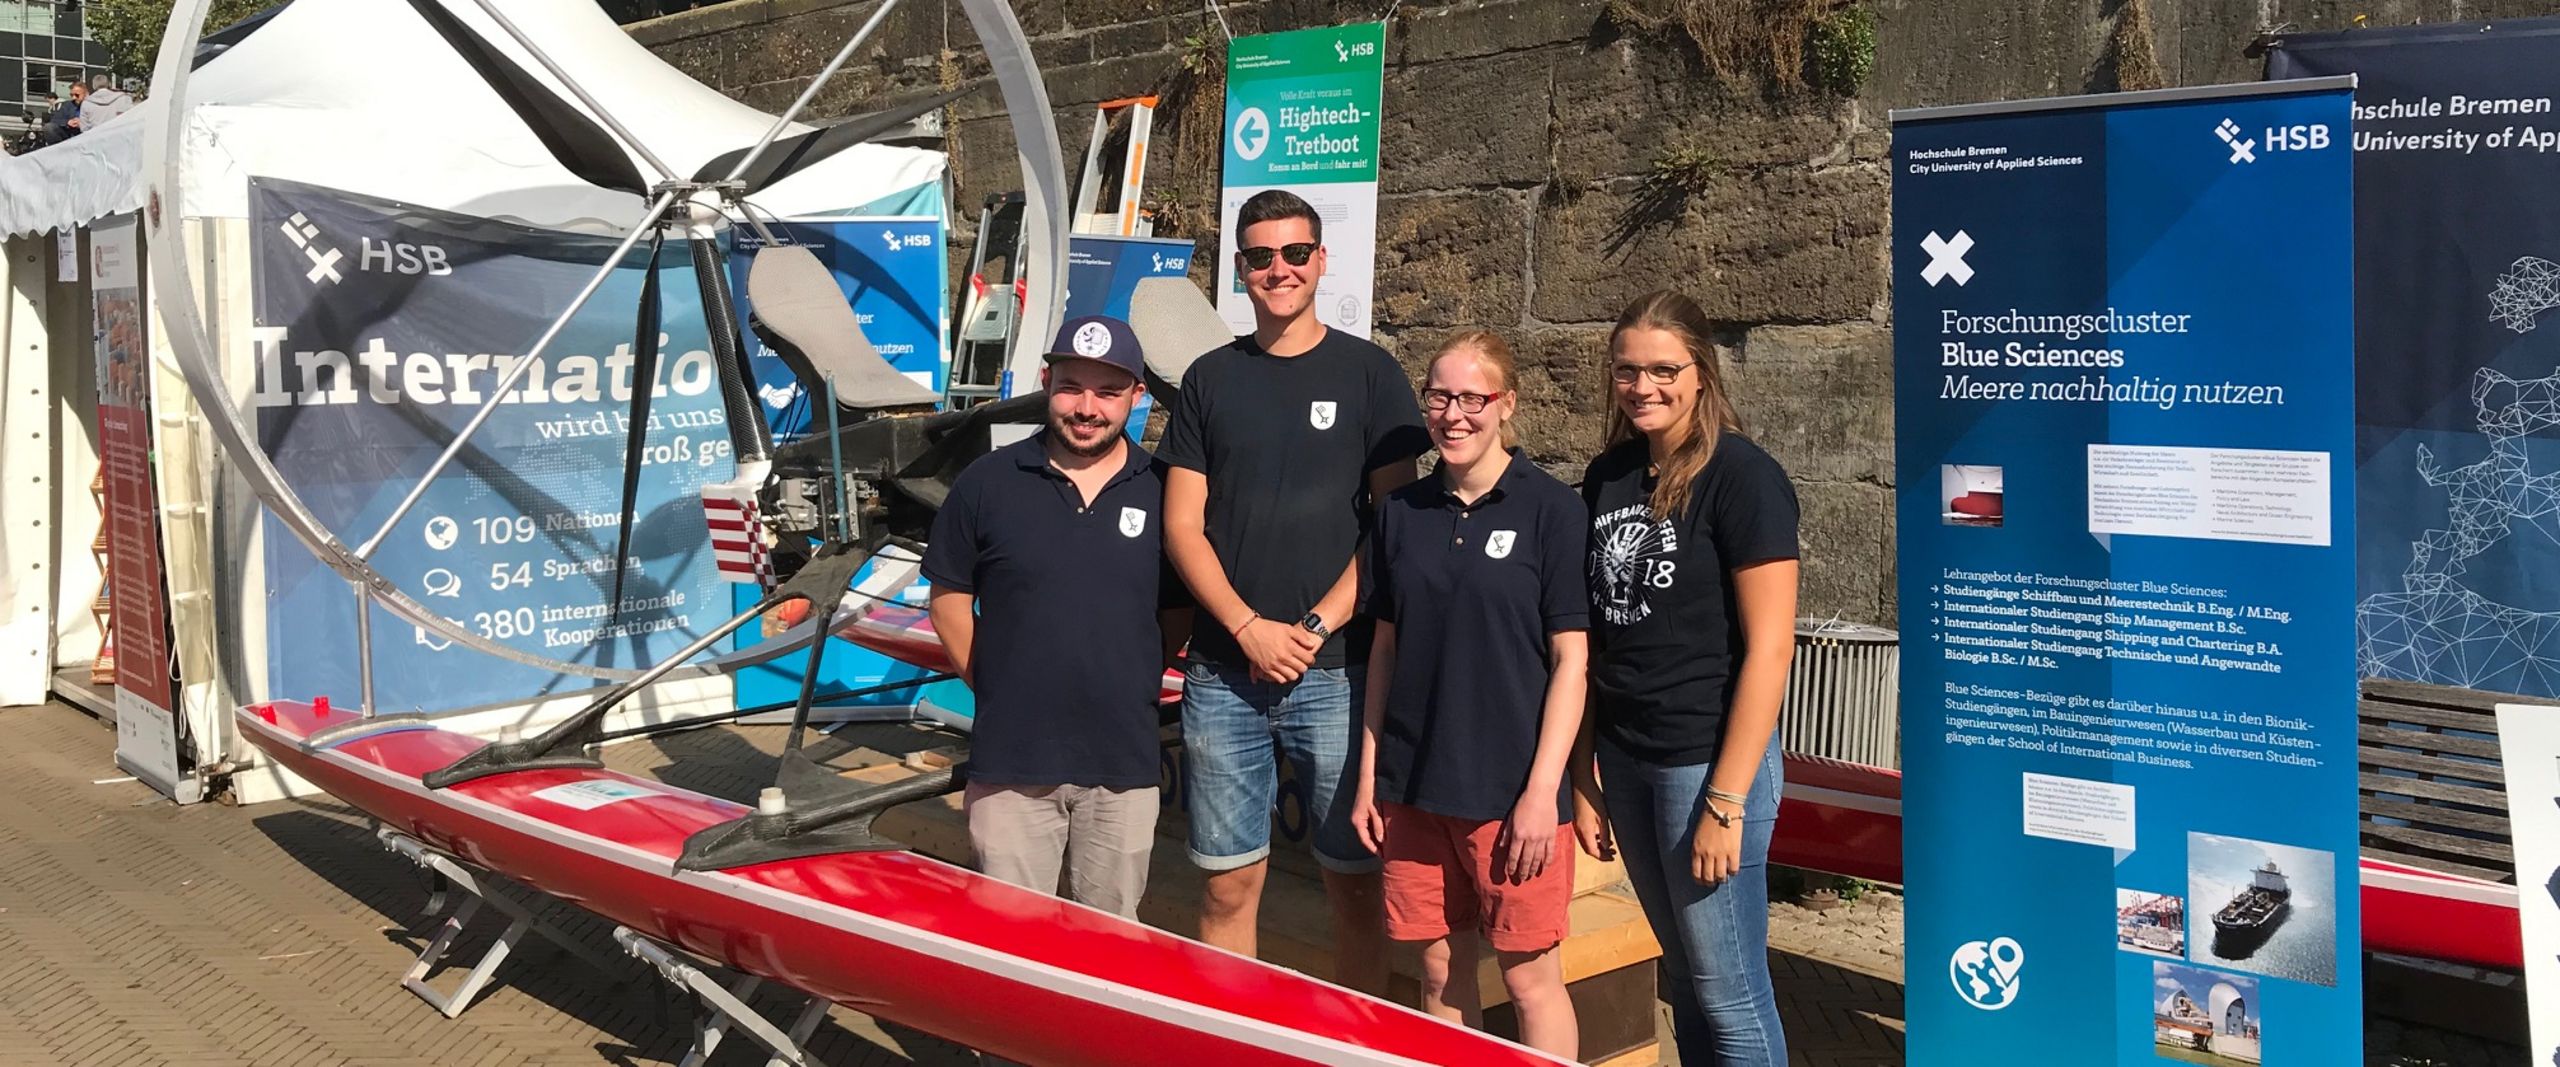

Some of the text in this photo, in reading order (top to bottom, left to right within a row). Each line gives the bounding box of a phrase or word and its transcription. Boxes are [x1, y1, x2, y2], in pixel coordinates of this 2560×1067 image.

[1351, 42, 1374, 56] HSB
[1298, 89, 1316, 99] Kraft
[2449, 95, 2551, 116] Bremen
[1279, 102, 1370, 132] Hightech-
[1284, 133, 1360, 155] Tretboot
[1910, 146, 2007, 160] Hochschule Bremen
[2265, 124, 2330, 152] HSB
[2353, 128, 2480, 154] University
[2486, 126, 2514, 148] of
[1268, 158, 1368, 172] Komm an Bord und fahr mit!
[1910, 156, 2083, 175] City University of Applied Sciences
[904, 234, 932, 247] HSB
[360, 236, 453, 277] HSB
[1164, 258, 1185, 270] HSB
[1941, 307, 2191, 340] Forschungscluster
[1941, 342, 2124, 368] Blue Sciences
[1940, 375, 2284, 410] Meere nachhaltig nutzen
[535, 408, 724, 439] wird bi uns
[623, 435, 692, 472] roß
[472, 516, 536, 544] 109
[490, 554, 642, 591] 54 Sprachn
[1642, 558, 1676, 588] 18
[1944, 568, 2227, 598] Lehrangebot der Forschungscluster Blue Sciences:
[1605, 600, 1652, 625] BREMEN
[1944, 584, 2020, 602] Studiengänge
[2022, 589, 2077, 604] Schiffbau
[2079, 595, 2101, 606] und
[2104, 596, 2195, 613] Meerestechnik
[2197, 602, 2236, 618] B.Eng.
[2247, 607, 2292, 624] M.Eng.
[1944, 600, 2246, 634] Internationaler Studiengang Ship Management B.Sc.
[474, 607, 536, 641] 380
[544, 614, 690, 648] Kooperationen
[1944, 616, 2283, 656] Internationaler Studiengang Shipping and Chartering B.A.
[1944, 632, 2282, 673] Internationaler Studiengang Technische und Angewandte
[1944, 649, 1989, 664] Biologie
[1991, 652, 2018, 665] B.Sc.
[2027, 656, 2059, 669] M.Sc.
[1944, 682, 1969, 694] Blue
[2068, 695, 2090, 708] gibt
[2092, 700, 2104, 708] es
[2106, 698, 2152, 714] darüber
[2155, 703, 2197, 718] hinaus
[2200, 711, 2220, 721] u.a.
[2224, 710, 2236, 722] in
[2239, 712, 2262, 726] den
[2265, 715, 2315, 730] Bionik-
[2032, 707, 2047, 718] im
[2050, 708, 2165, 732] Bauingenieurwesen
[2167, 721, 2239, 740] (Wasserbau
[2241, 730, 2266, 744] und
[2268, 732, 2321, 749] Küsten-
[1945, 731, 2194, 769] gängen der School of International Business.
[2042, 724, 2153, 747] Politikmanagement
[2156, 739, 2192, 752] sowie
[2194, 742, 2207, 754] in
[2210, 744, 2264, 761] diversen
[2266, 750, 2324, 768] Studien-
